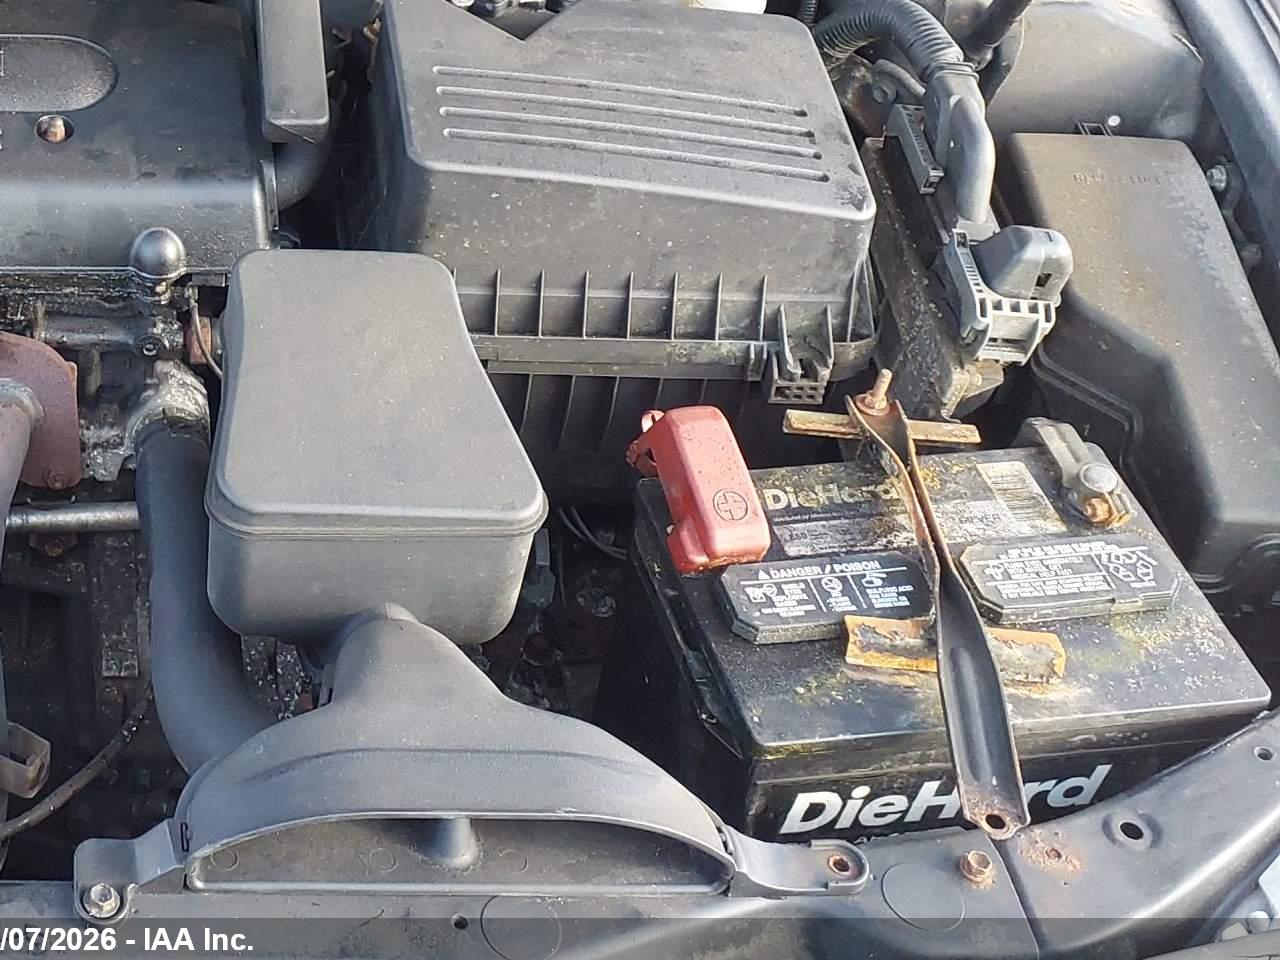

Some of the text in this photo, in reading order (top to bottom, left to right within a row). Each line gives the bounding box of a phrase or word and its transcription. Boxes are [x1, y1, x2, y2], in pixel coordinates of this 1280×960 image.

[770, 560, 881, 579] DANGER / POISON
[779, 764, 1113, 835] DieHrd
